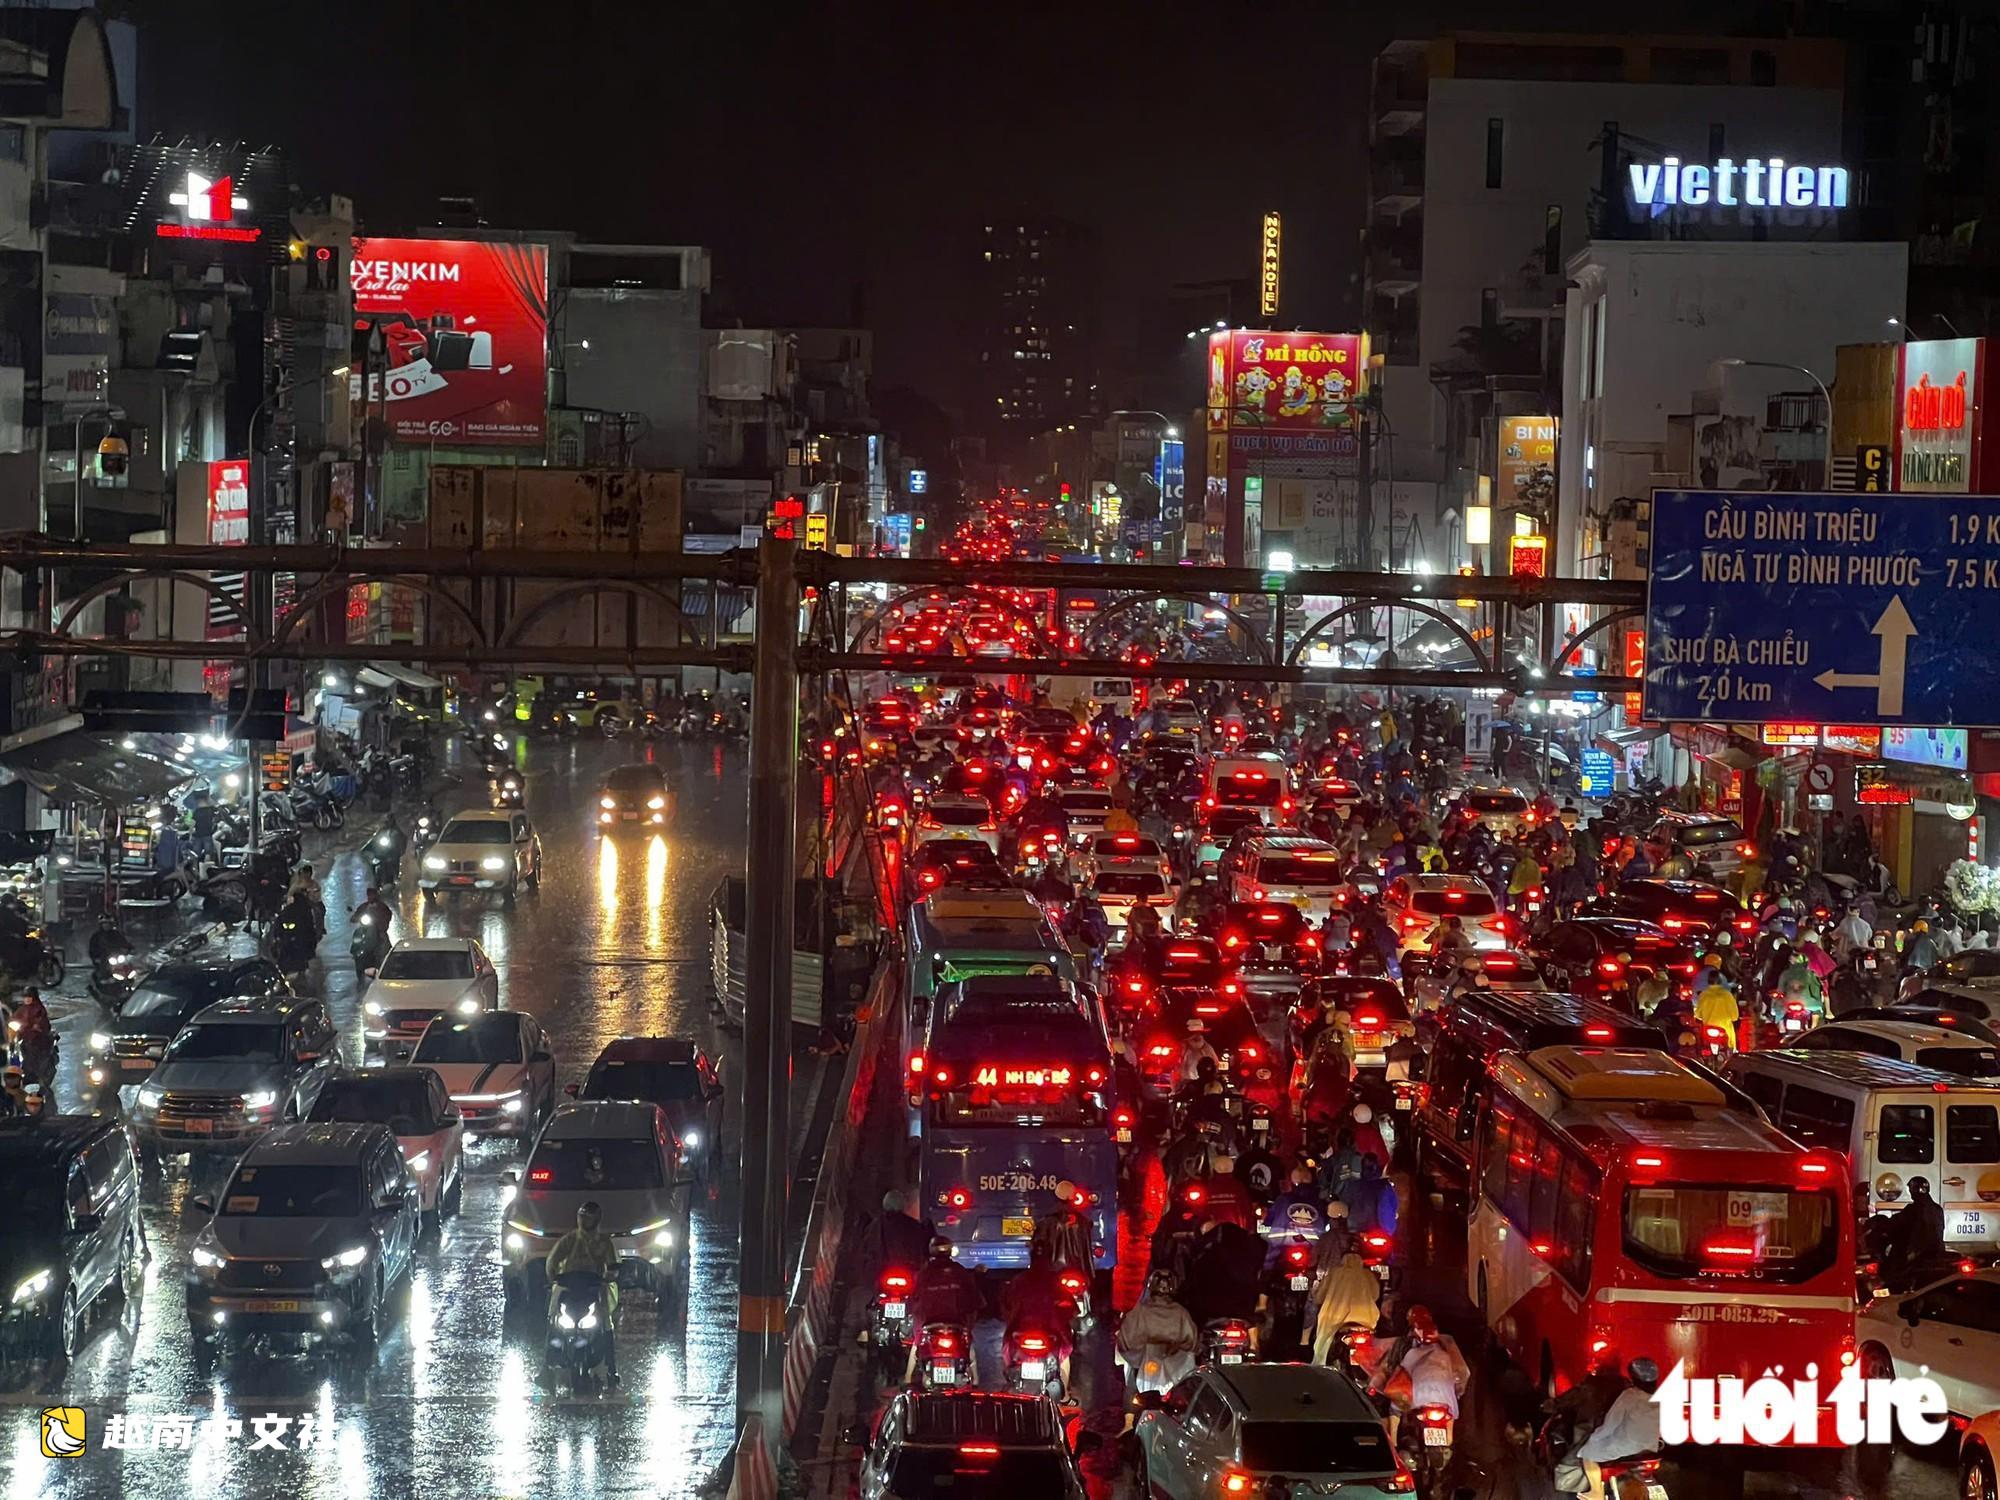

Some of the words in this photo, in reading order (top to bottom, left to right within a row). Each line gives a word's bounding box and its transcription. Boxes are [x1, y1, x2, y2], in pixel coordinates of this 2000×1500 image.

[1629, 157, 1848, 207] viettien
[1265, 217, 1278, 258] NOLA
[1264, 262, 1277, 312] HOTEL
[1295, 342, 1347, 363] HỒNG
[1704, 499, 1747, 540] CẦU
[1754, 504, 1806, 541] BÌNH
[1814, 507, 1877, 547] TRIỆU
[1949, 514, 1980, 546] 1,9
[1701, 549, 1746, 583] NGÃ
[1753, 552, 1782, 582] TƯ
[1787, 548, 1839, 584] BÌNH
[1847, 550, 1921, 586] PHƯỚC
[1946, 559, 1978, 590] 7,5
[1665, 638, 1708, 667] CHỢ
[1713, 633, 1740, 664] BÀ
[1747, 629, 1809, 665] CHIỂU
[1737, 676, 1772, 701] km
[977, 1068, 997, 1086] 44
